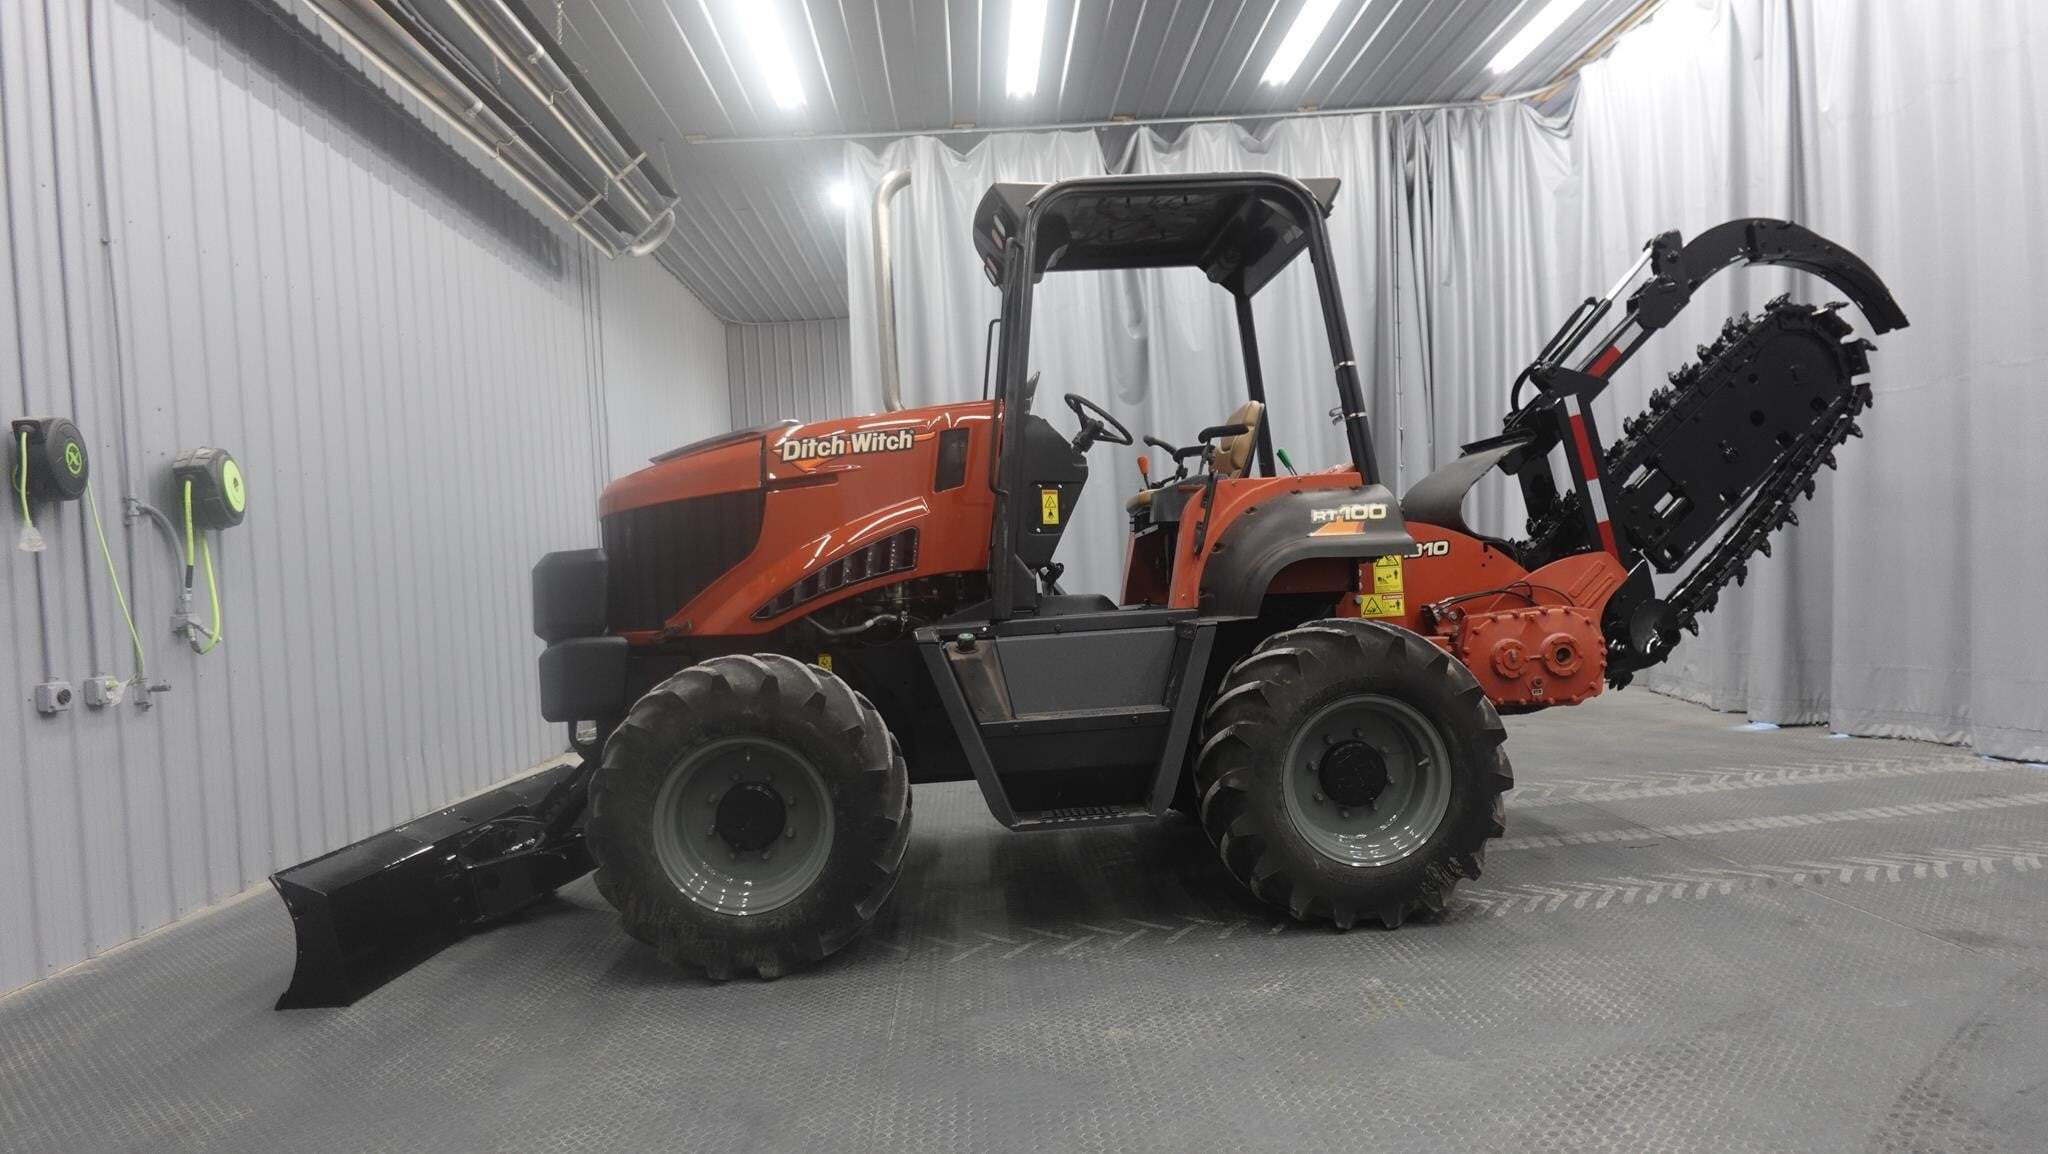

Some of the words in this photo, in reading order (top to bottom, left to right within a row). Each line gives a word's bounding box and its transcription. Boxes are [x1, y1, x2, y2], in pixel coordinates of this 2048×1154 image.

[783, 436, 845, 461] Ditch
[851, 431, 913, 453] Witch
[1311, 503, 1388, 521] RT100
